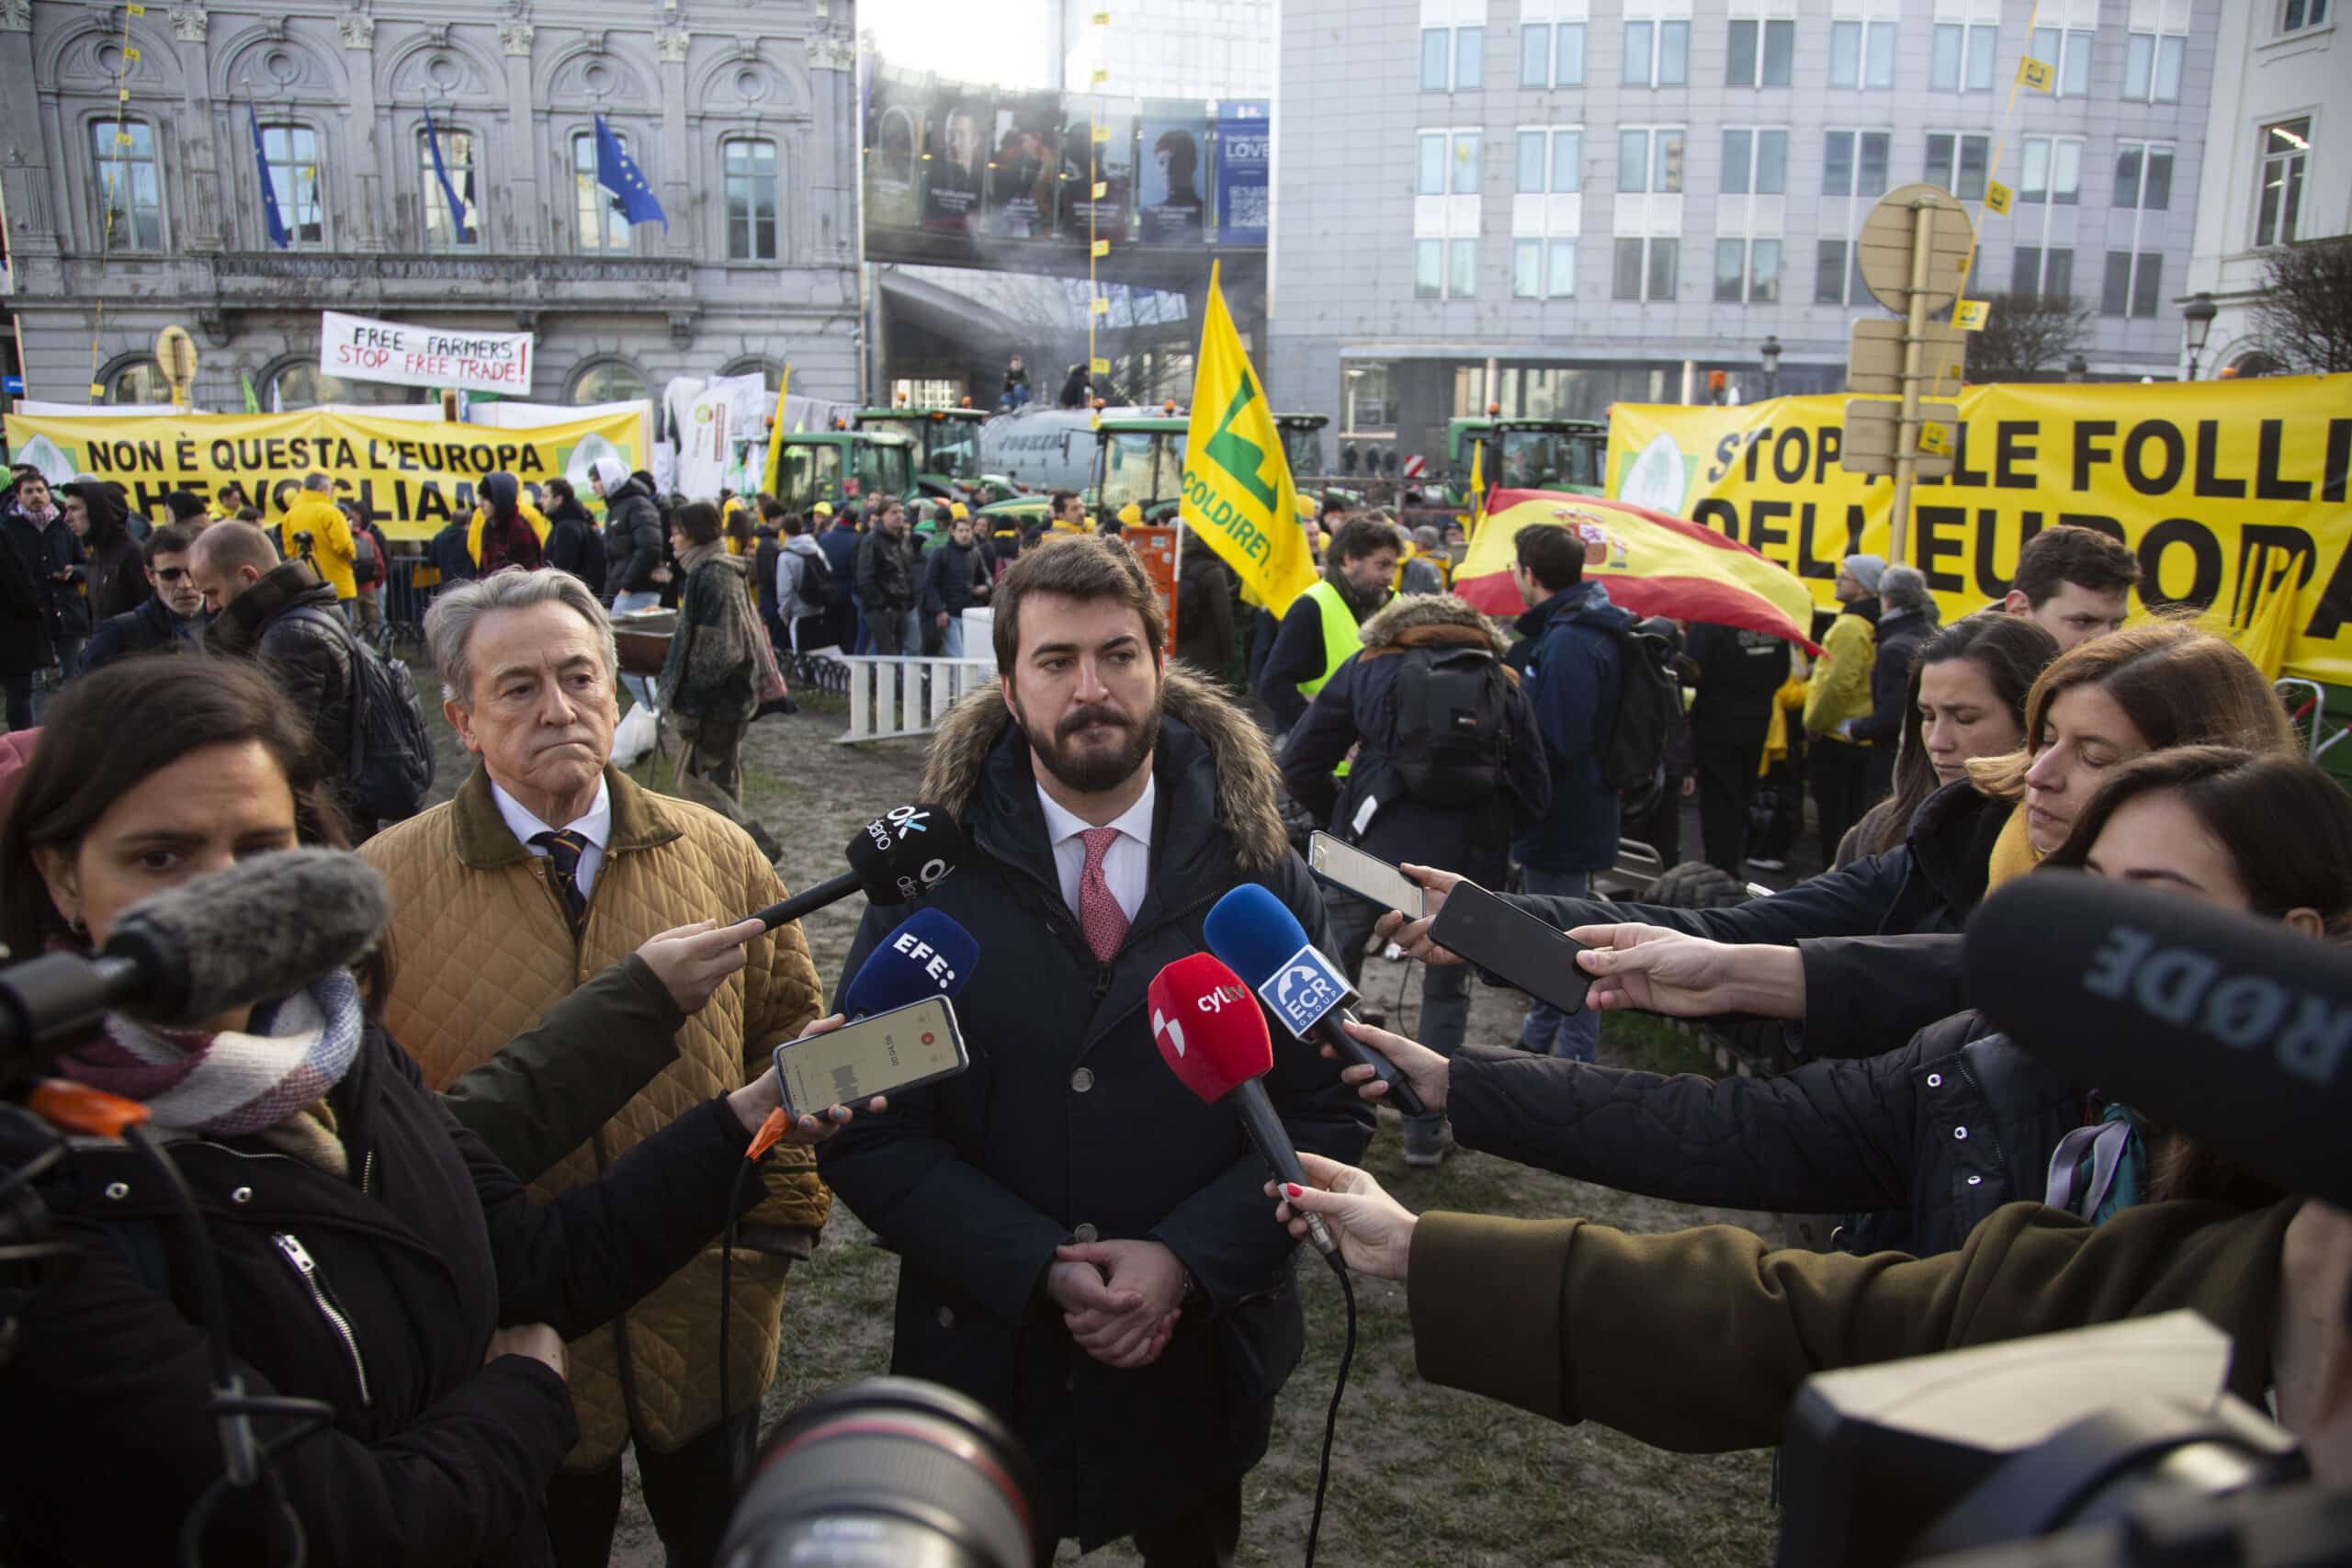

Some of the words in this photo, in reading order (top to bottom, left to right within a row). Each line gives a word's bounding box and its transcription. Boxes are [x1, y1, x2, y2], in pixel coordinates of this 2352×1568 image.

[338, 344, 390, 367] STOP
[404, 353, 448, 375] FREE
[353, 327, 405, 351] FREE
[426, 335, 513, 359] FARMERS
[86, 440, 164, 471] NON
[176, 432, 198, 471] È
[210, 437, 358, 473] QUESTA
[1707, 425, 1843, 486] STOP
[887, 806, 931, 840] OK
[1285, 977, 1331, 1021] ECR
[1298, 988, 1337, 1026] GROUP
